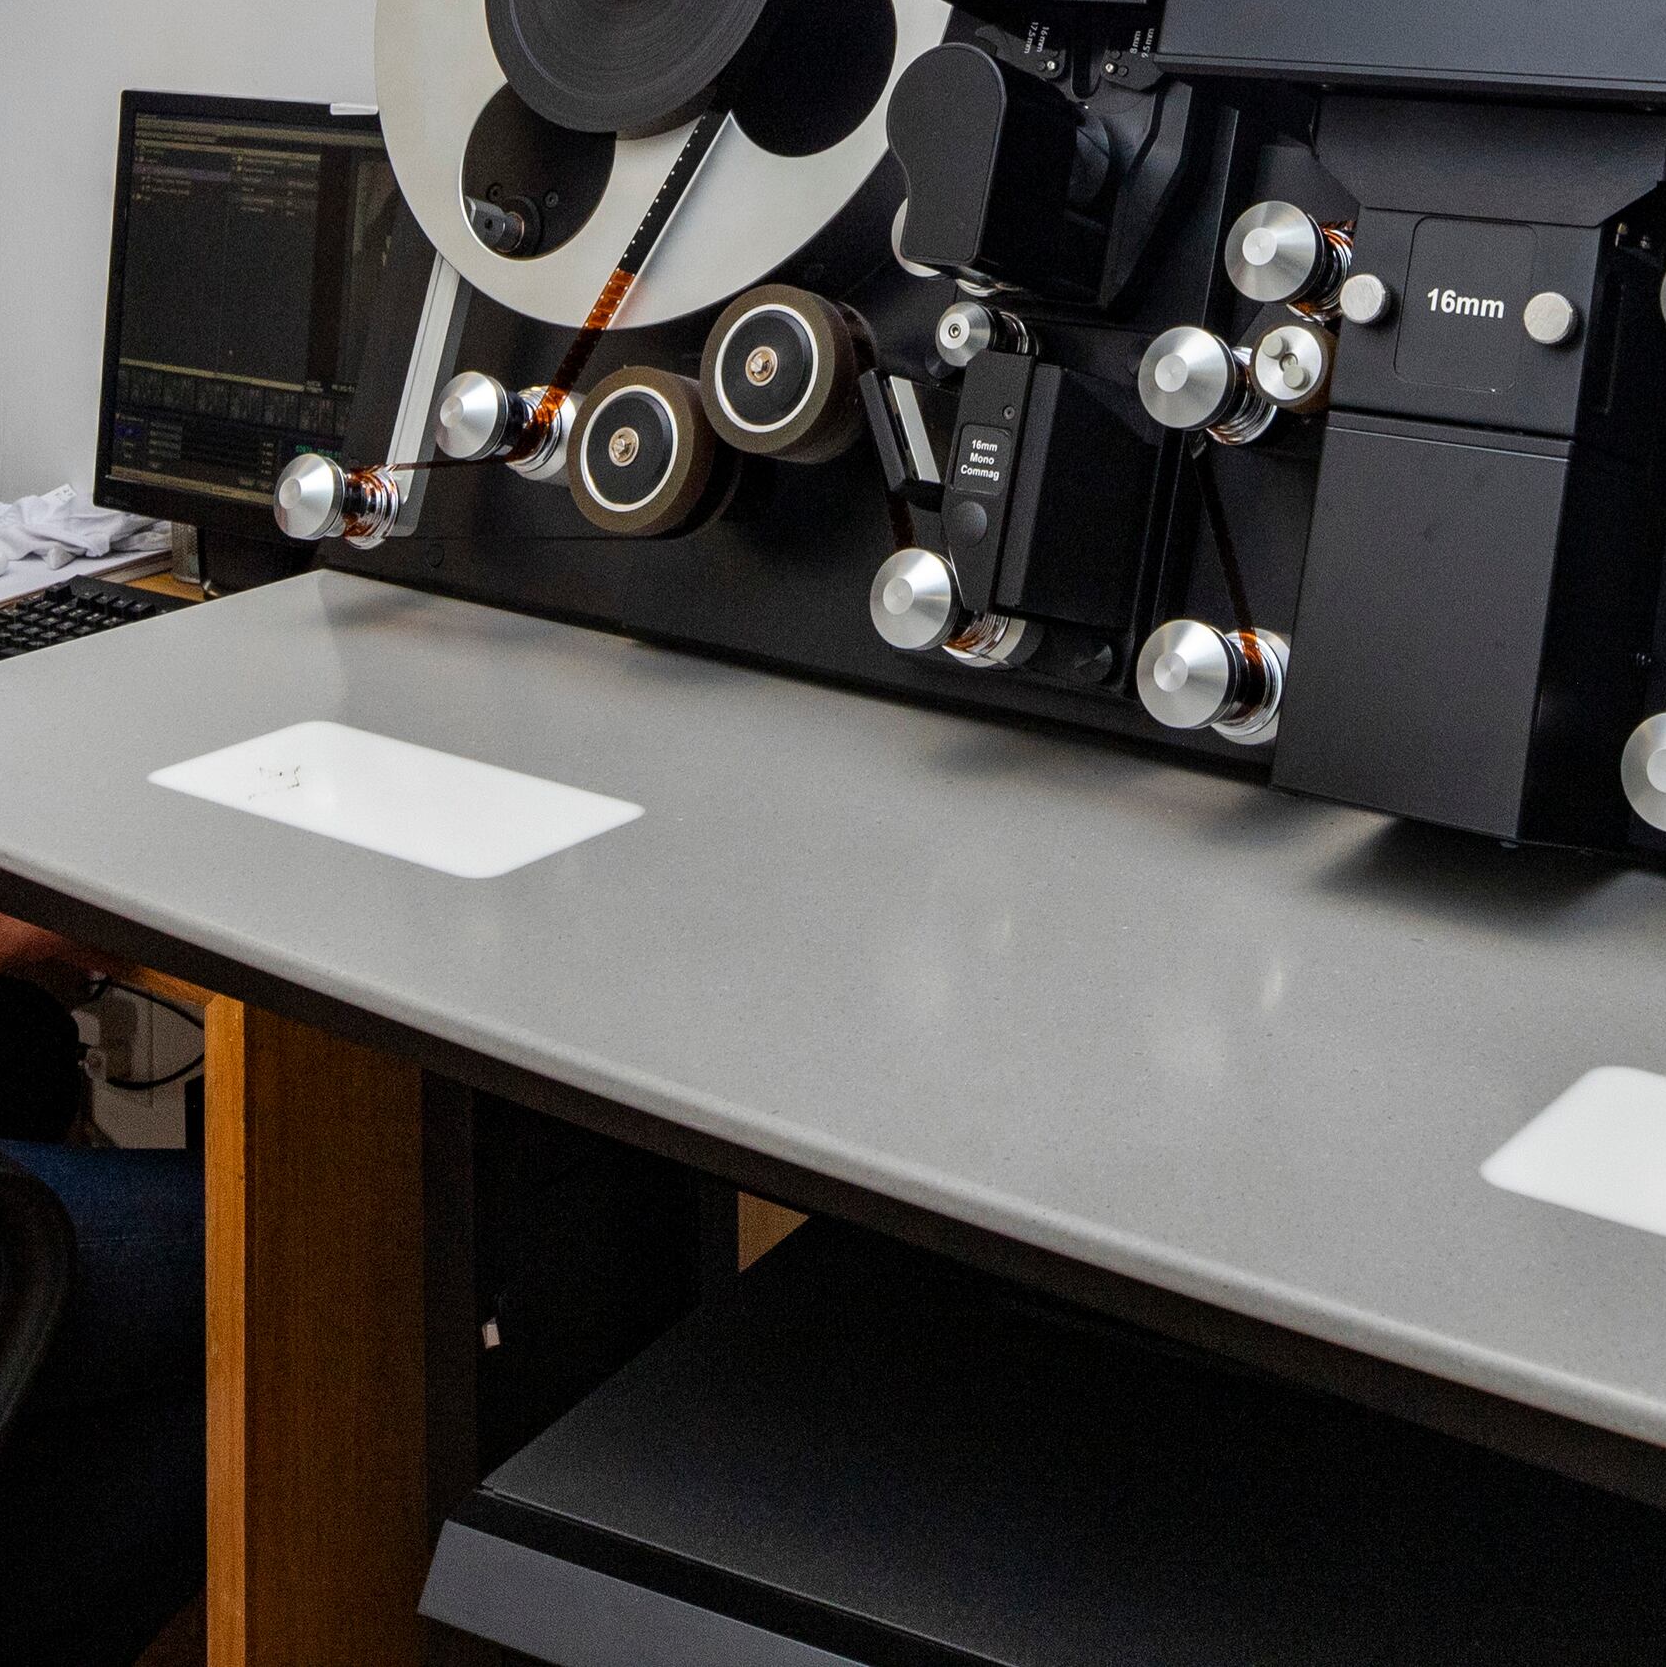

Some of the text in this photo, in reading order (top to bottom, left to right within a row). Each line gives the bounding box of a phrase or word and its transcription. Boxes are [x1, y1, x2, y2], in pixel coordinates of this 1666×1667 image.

[1427, 288, 1505, 319] 16mm
[972, 439, 998, 452] 16mm
[970, 452, 995, 465] Mono
[961, 464, 1000, 481] Commag
